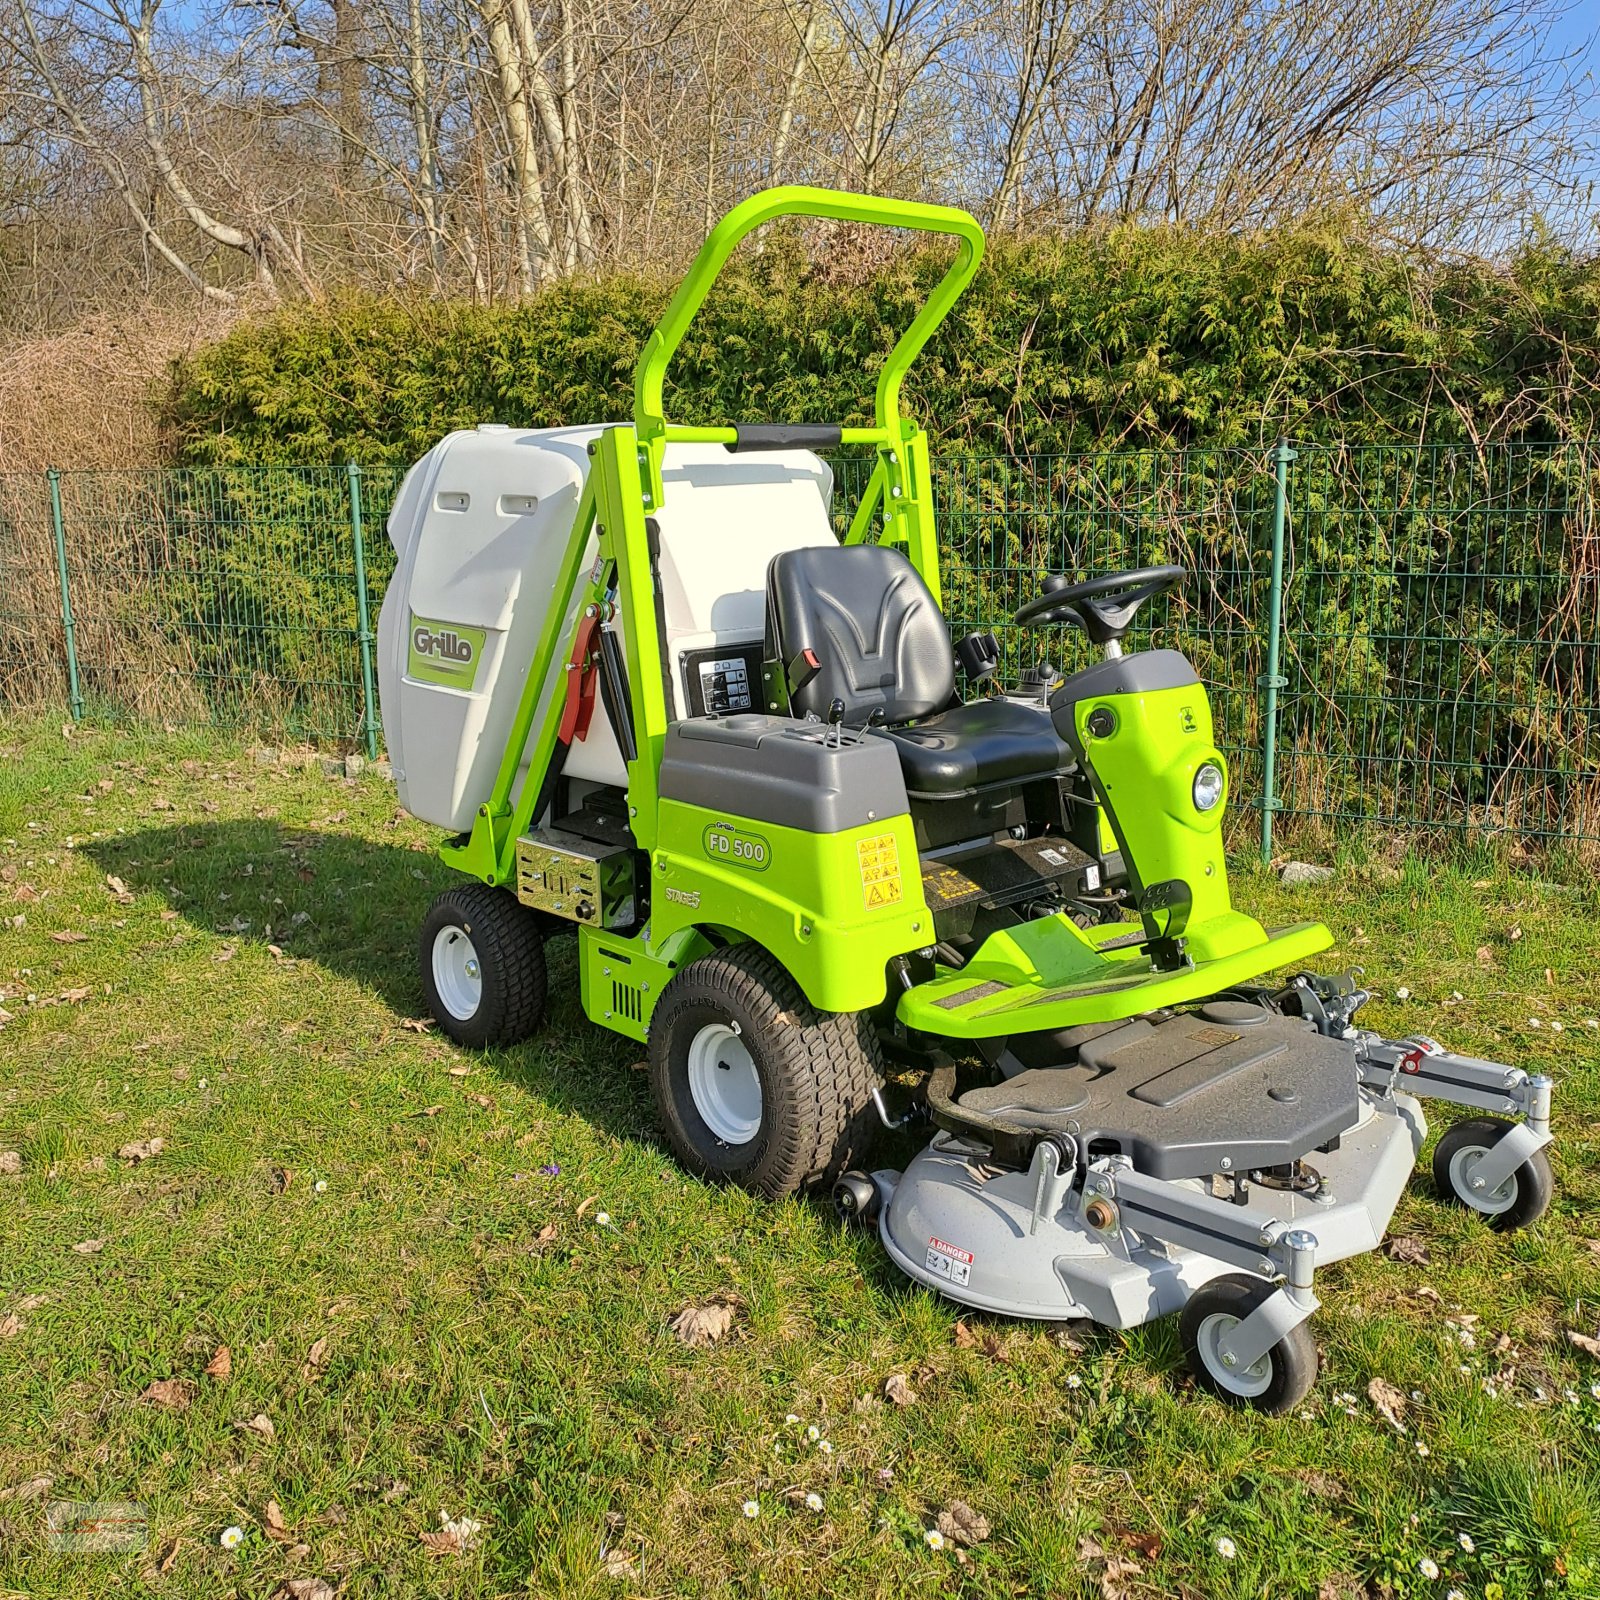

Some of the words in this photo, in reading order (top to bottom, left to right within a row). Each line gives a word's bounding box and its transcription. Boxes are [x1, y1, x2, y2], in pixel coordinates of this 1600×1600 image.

[413, 627, 473, 663] Grillo
[709, 833, 730, 853] FD
[733, 838, 765, 862] 500
[936, 1241, 970, 1262] DANGER
